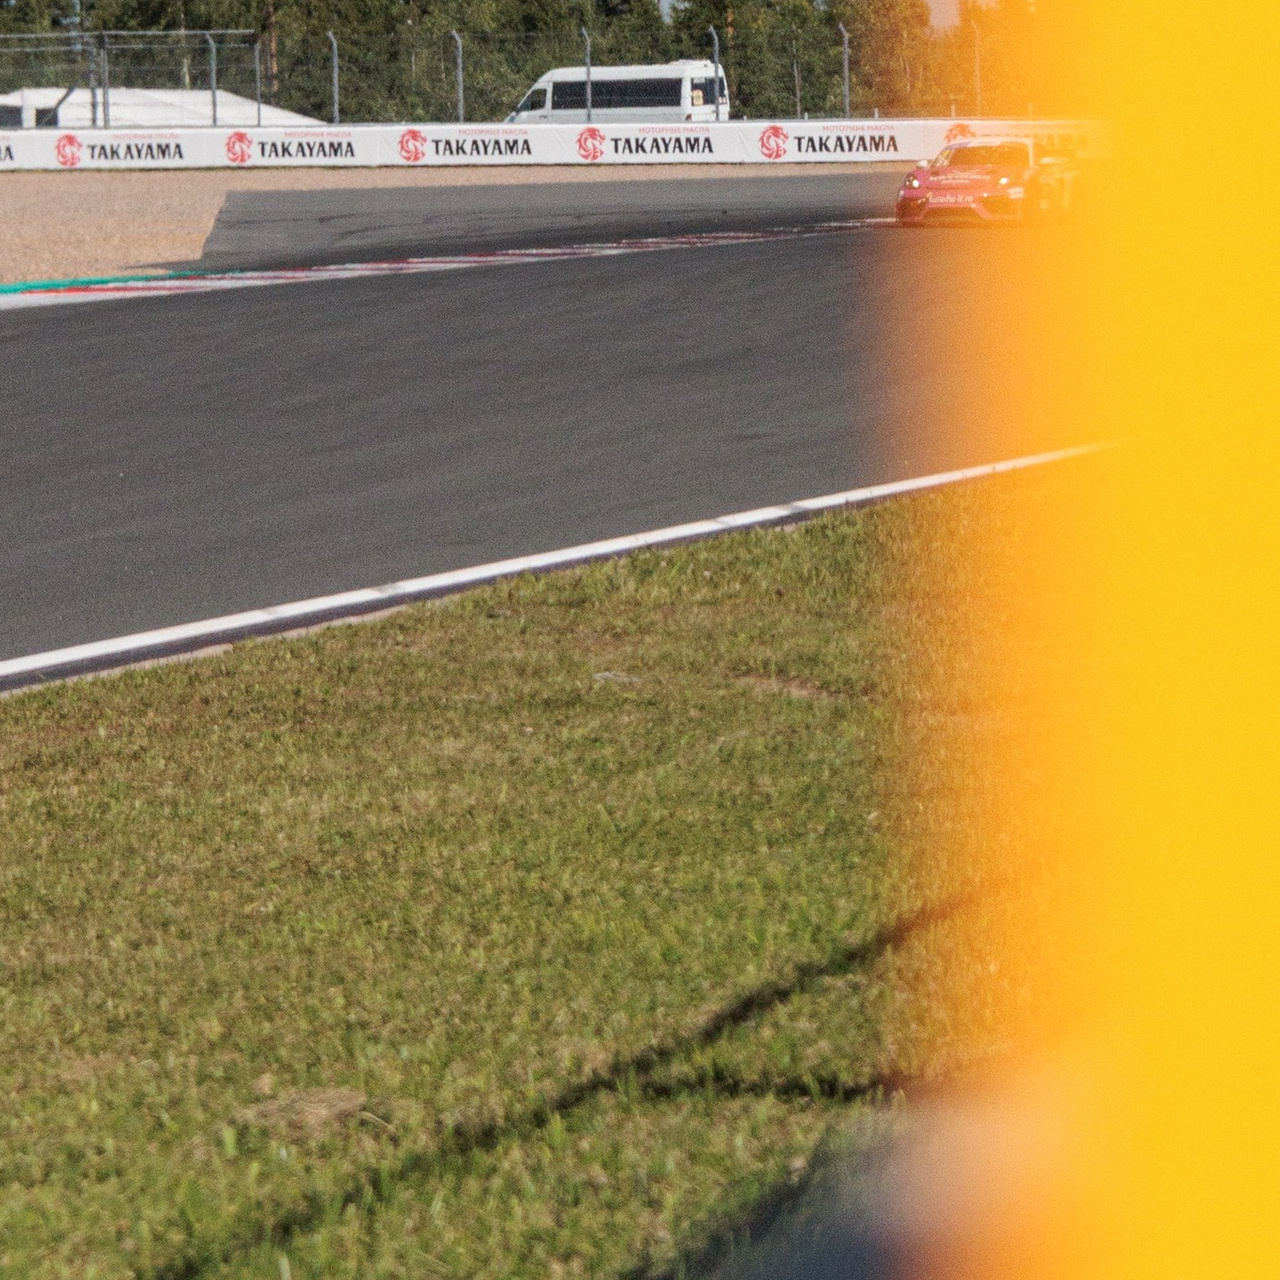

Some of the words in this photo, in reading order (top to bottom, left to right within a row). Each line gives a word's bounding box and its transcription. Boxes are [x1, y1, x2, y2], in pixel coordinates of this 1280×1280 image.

[88, 143, 184, 160] TAKAYAMA
[258, 141, 355, 158] TAKAYAMA
[432, 138, 532, 156] TAKAYAMA
[611, 136, 714, 154] TAKAYAMA
[794, 135, 898, 153] TAKAYAMA
